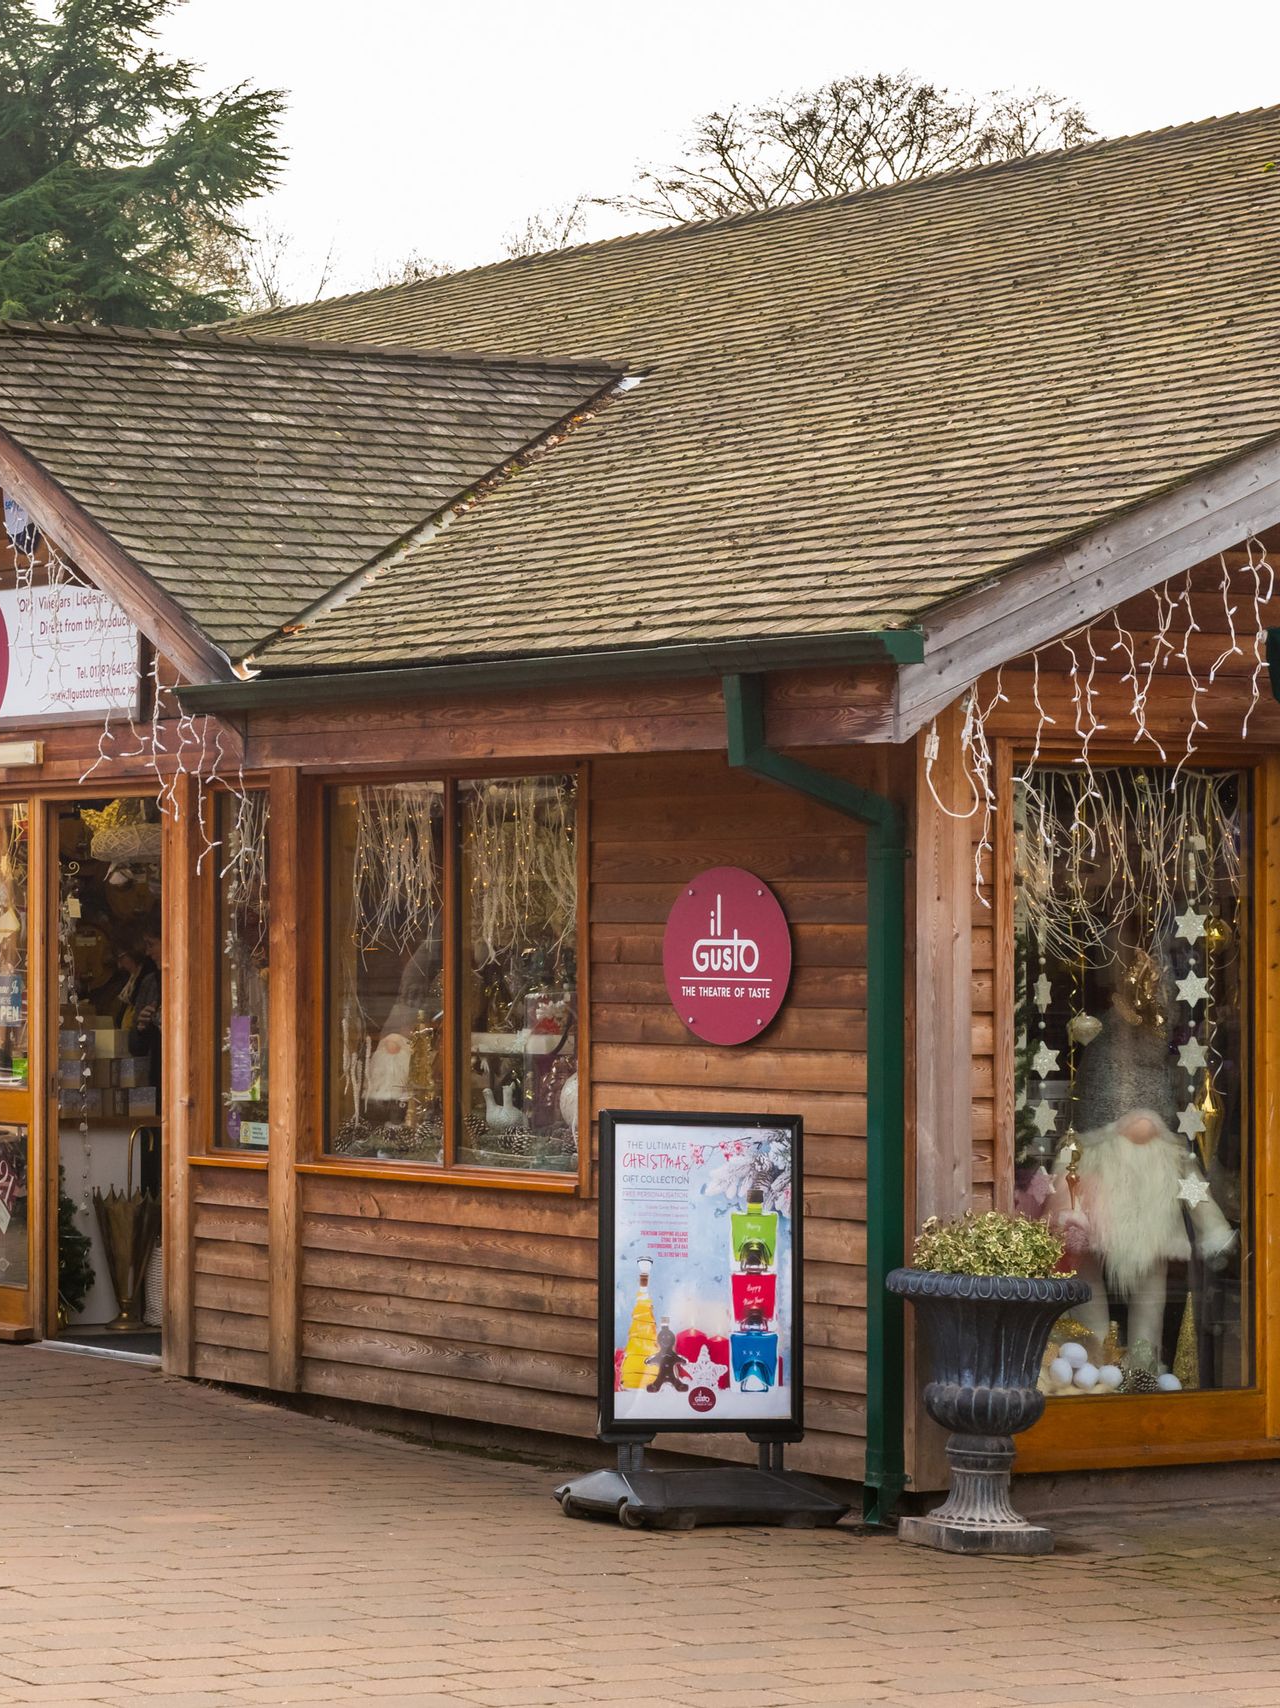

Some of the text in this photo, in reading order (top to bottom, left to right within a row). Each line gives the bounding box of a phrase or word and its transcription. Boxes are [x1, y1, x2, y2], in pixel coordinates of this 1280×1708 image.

[65, 618, 83, 632] from
[710, 893, 722, 937] il
[682, 986, 771, 999] THE THEATRE OF TASTE
[627, 1141, 687, 1151] THE ULTIMATE
[622, 1174, 689, 1184] GIFT COLLECTION
